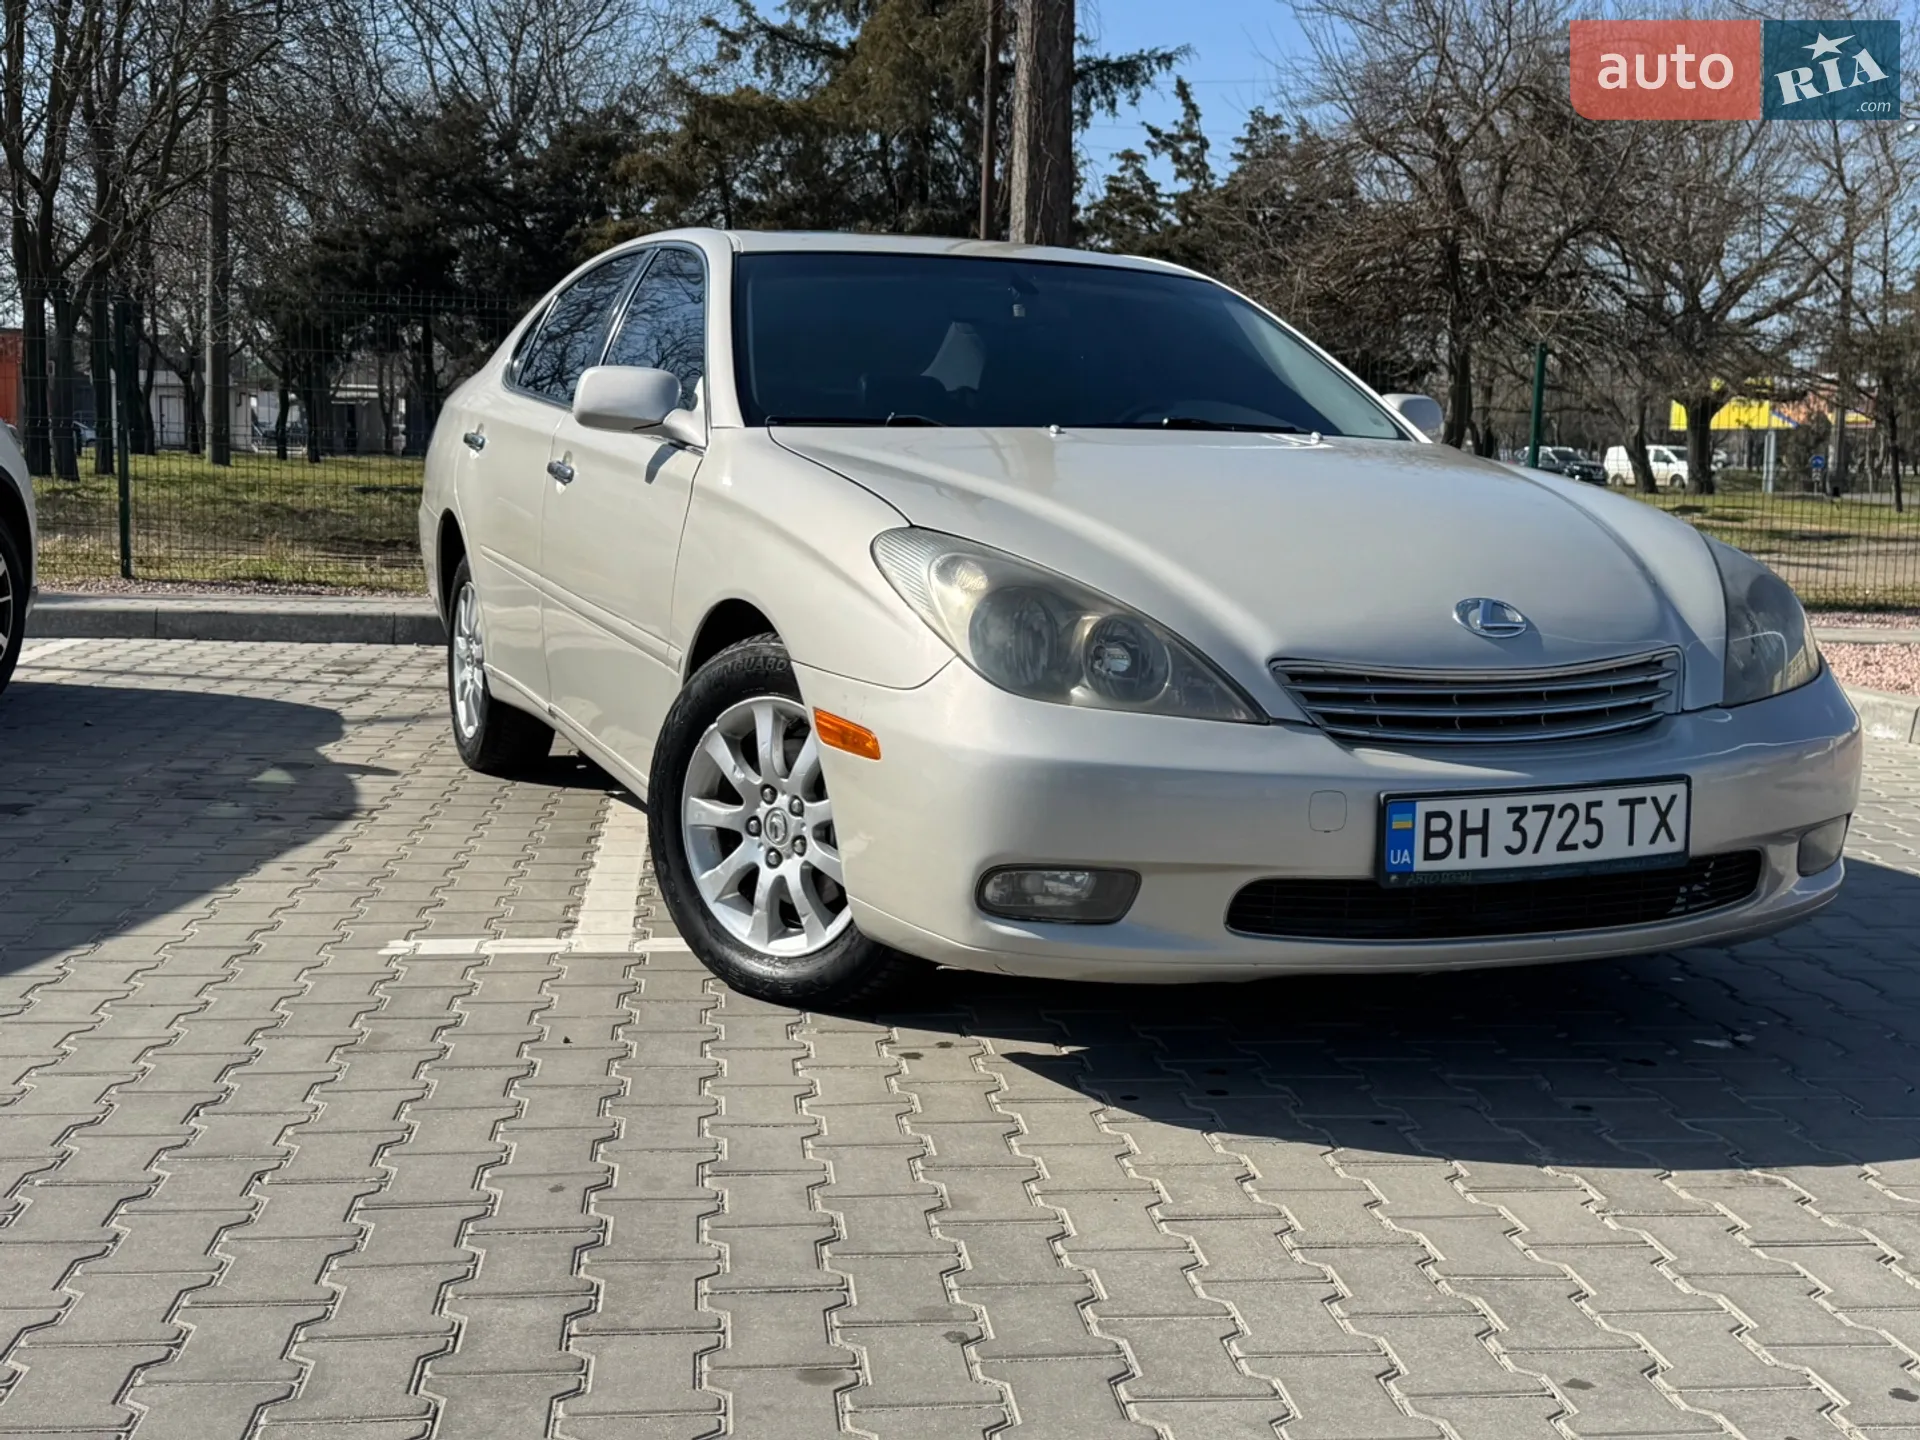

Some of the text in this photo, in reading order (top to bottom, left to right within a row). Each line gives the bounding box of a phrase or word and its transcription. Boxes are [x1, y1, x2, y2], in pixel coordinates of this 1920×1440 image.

[1423, 794, 1678, 861] BH 3725 TX
[1390, 849, 1411, 865] UA
